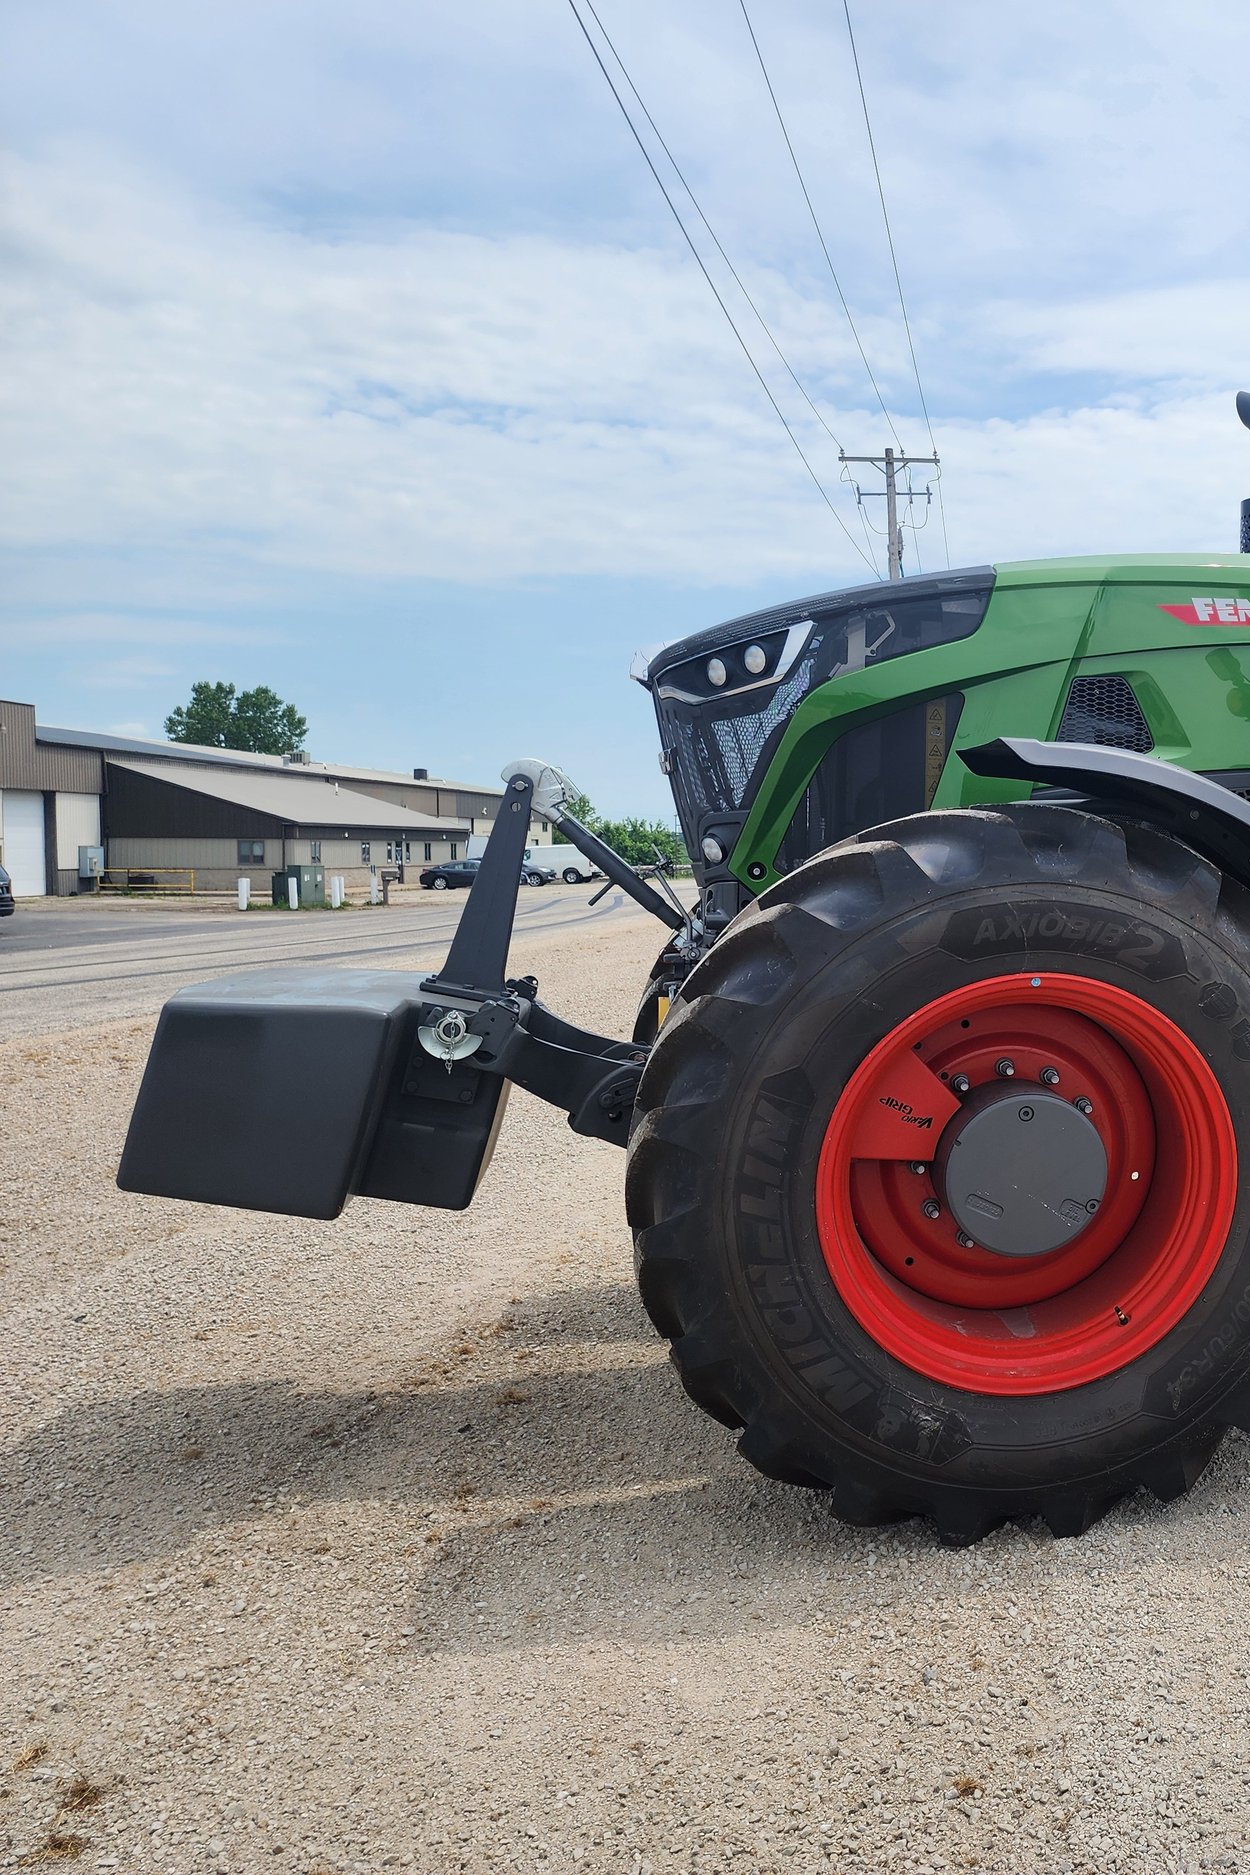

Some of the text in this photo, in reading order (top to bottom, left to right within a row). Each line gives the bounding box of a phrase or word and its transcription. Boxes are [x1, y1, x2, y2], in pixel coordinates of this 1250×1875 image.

[973, 912, 1127, 946] AXIOBIB
[879, 1096, 913, 1115] GRIP
[740, 1098, 875, 1413] MICHELIN
